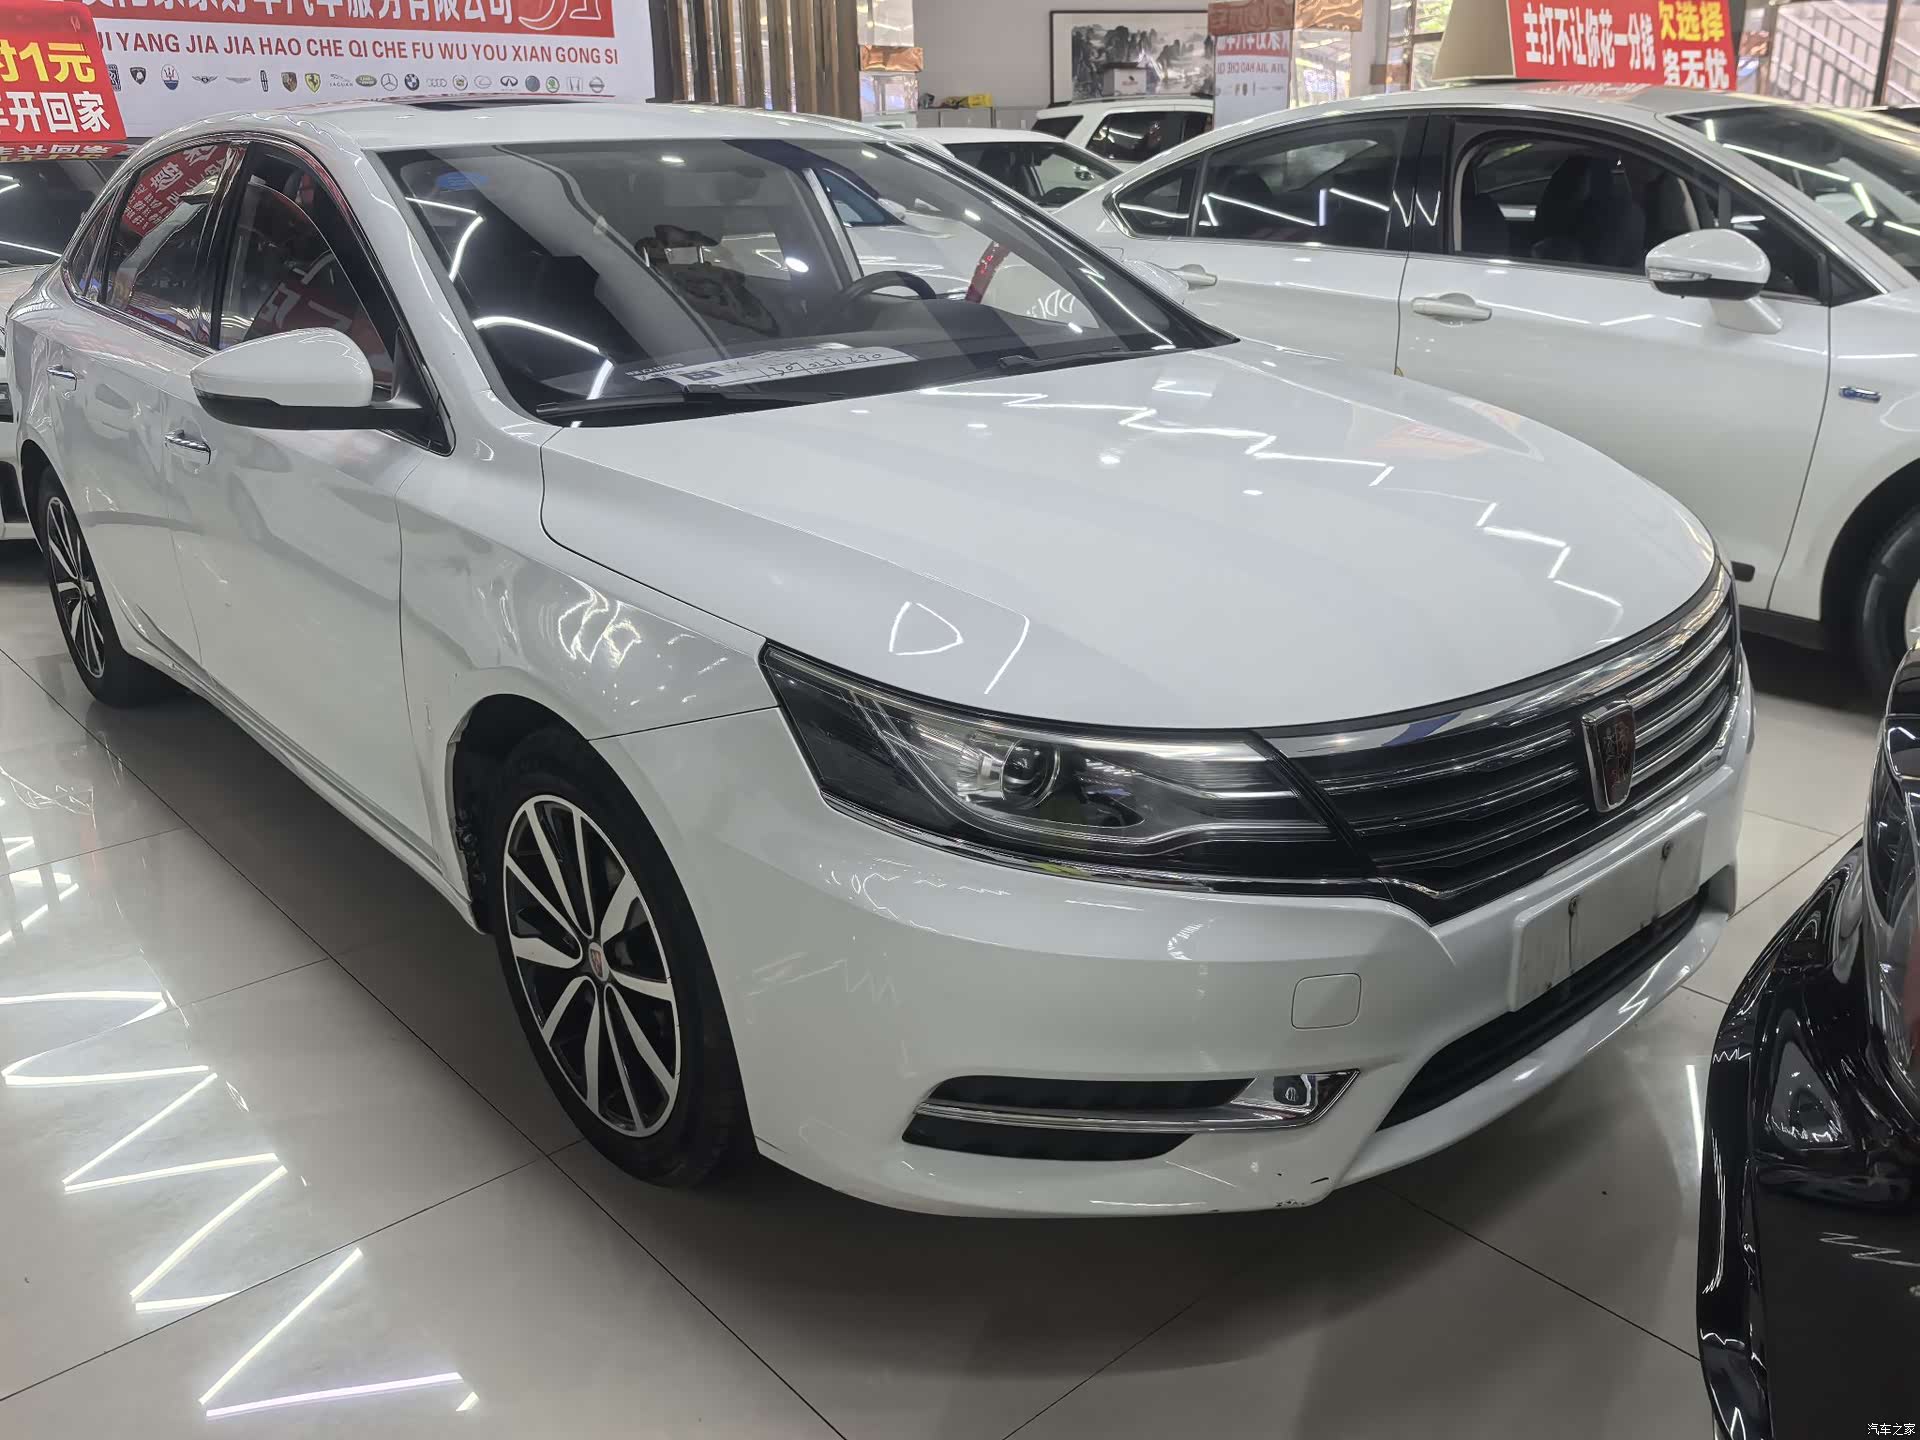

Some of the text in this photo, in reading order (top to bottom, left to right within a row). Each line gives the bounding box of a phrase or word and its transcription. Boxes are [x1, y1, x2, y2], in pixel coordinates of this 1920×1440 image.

[116, 32, 180, 52] YANG
[186, 35, 219, 54] JIA
[224, 36, 255, 55] JIA
[260, 37, 301, 56] HAO
[307, 38, 344, 57] CHE
[348, 40, 367, 59] QI
[373, 41, 407, 58] CHE
[412, 42, 434, 59] FU
[438, 43, 468, 60] WU
[472, 44, 508, 61] YOU
[513, 45, 552, 63] XIAN
[556, 47, 601, 64] GONG
[605, 49, 619, 65] SI
[1523, 2, 1656, 71] 主打不让你花一分钱
